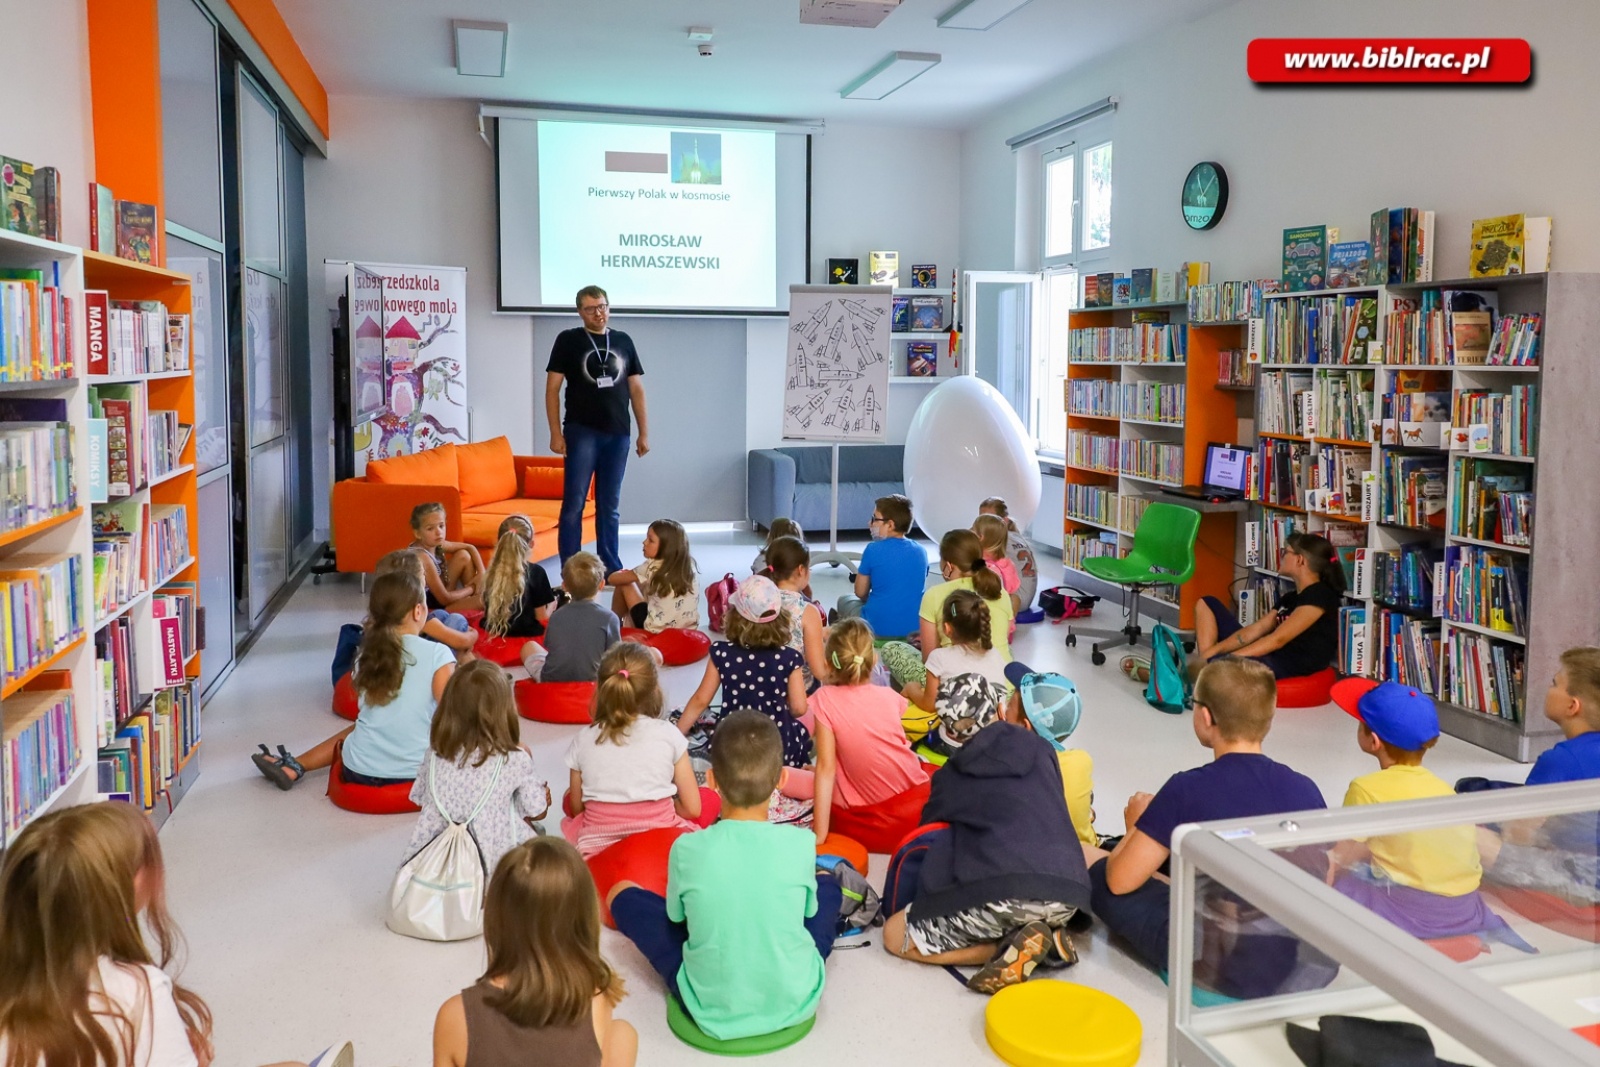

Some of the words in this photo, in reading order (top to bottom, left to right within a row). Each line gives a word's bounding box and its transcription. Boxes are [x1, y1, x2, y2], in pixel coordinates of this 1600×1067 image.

[588, 187, 635, 200] Pierwszy
[638, 188, 667, 199] Polak
[681, 190, 731, 201] kosmosie
[619, 233, 702, 248] MIROSŁAW
[601, 254, 720, 269] HERMASZEWSKI
[382, 274, 439, 291] zedszkola
[430, 298, 457, 314] mola
[89, 306, 103, 363] MANGA
[90, 435, 100, 487] KOMIKSY
[1017, 550, 1035, 577] 2
[167, 627, 178, 676] NASTOLATKI
